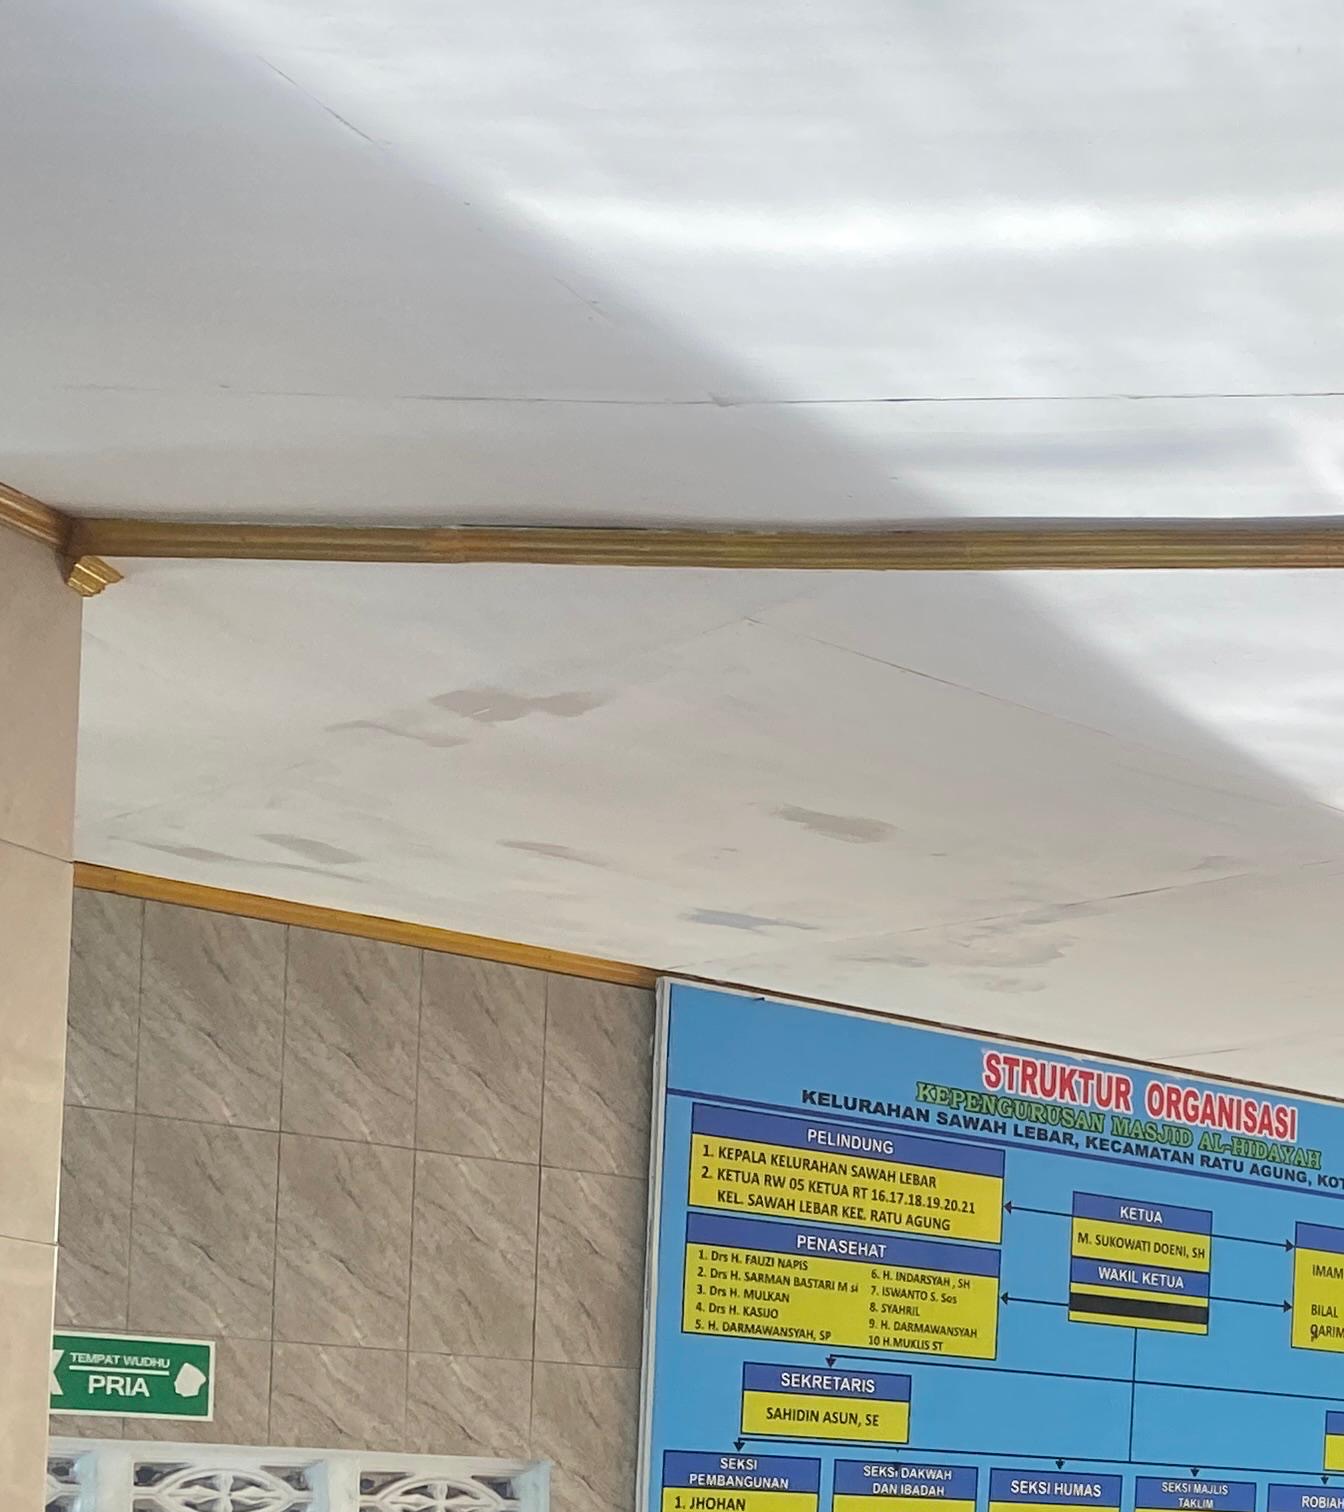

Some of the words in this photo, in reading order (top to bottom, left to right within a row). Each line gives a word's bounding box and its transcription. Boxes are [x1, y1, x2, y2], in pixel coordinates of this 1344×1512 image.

[983, 1050, 1132, 1113] STRUKTUR
[1146, 1081, 1297, 1141] ORGANISASI
[916, 1081, 1105, 1133] KEPENGURUSAN
[1112, 1116, 1193, 1147] MASJID
[1200, 1132, 1322, 1170] AL-HIDAYAH
[802, 1089, 930, 1122] KELURAHAN
[937, 1111, 1006, 1135] SAWAH
[1014, 1124, 1079, 1149] LEBAR,
[1086, 1132, 1194, 1166] KECAMATAN
[1200, 1156, 1244, 1173] RATU
[1250, 1163, 1312, 1186] AGUNG,
[807, 1128, 894, 1154] PELINDUNG
[702, 1144, 714, 1157] 1.
[718, 1146, 766, 1165] KEPALA
[770, 1153, 847, 1176] KELURAHAN
[851, 1165, 896, 1183] SAWAH
[899, 1172, 937, 1188] LEBAR
[701, 1166, 713, 1179] 2.
[717, 1168, 759, 1186] KETUA
[764, 1174, 785, 1189] RW
[789, 1178, 804, 1191] 05
[808, 1179, 850, 1196] KETUA
[852, 1187, 867, 1200] RT
[871, 1189, 975, 1214] 16.17.18.19.20.21
[717, 1190, 743, 1204] KEL.
[748, 1194, 796, 1212] SAWAH
[800, 1201, 838, 1217] LEBAR
[870, 1209, 902, 1224] RATU
[906, 1214, 951, 1231] AGUNG
[1120, 1206, 1163, 1223] KETUA
[797, 1234, 887, 1258] PENASEHAT
[1077, 1232, 1092, 1244] M.
[1095, 1234, 1151, 1253] SUKOWATI
[1153, 1242, 1189, 1258] DOENI,
[1192, 1247, 1205, 1259] SH
[698, 1250, 707, 1260] 1.
[711, 1251, 728, 1262] Drs
[731, 1253, 742, 1263] H.
[745, 1254, 774, 1267] FAUZI
[778, 1258, 808, 1271] NAPIS
[697, 1267, 706, 1277] 2.
[710, 1268, 727, 1279] Drs
[730, 1270, 741, 1280] H.
[744, 1272, 790, 1286] SARMAN
[794, 1276, 835, 1290] BASTARI
[838, 1282, 848, 1291] M
[871, 1269, 880, 1279] 6.
[883, 1270, 892, 1280] H.
[896, 1272, 950, 1286] INDARSYAH
[958, 1278, 970, 1289] SH
[1098, 1266, 1138, 1283] WAKIL
[1142, 1271, 1184, 1288] KETUA
[1312, 1264, 1344, 1279] IMAM
[696, 1286, 706, 1295] 3.
[710, 1286, 726, 1297] Drs
[730, 1288, 740, 1298] H.
[744, 1289, 790, 1303] MULKAN
[882, 1286, 927, 1300] ISWANTO
[696, 1302, 705, 1312] 4.
[709, 1303, 725, 1314] Drs
[729, 1305, 740, 1315] H.
[881, 1303, 920, 1316] SYAHRIL
[1311, 1304, 1338, 1318] BILAL
[708, 1320, 718, 1331] H.
[722, 1321, 816, 1341] DARMAWANSYAH,
[819, 1329, 831, 1340] SP
[881, 1320, 890, 1330] H.
[894, 1321, 977, 1338] DARMAWANSYAH
[933, 1341, 943, 1351] ST
[70, 1352, 120, 1365] TEMPAT
[124, 1355, 170, 1368] WUDHU
[88, 1375, 150, 1397] PRIA
[781, 1372, 875, 1393] SEKRETARIS
[766, 1407, 819, 1422] SAHIDIN
[823, 1412, 862, 1428] ASUN,
[865, 1414, 879, 1426] SE
[720, 1458, 757, 1470] SEKSI
[689, 1473, 789, 1489] PEMBANGUNAN
[901, 1467, 952, 1480] DAKWAH
[872, 1483, 897, 1495] DAN
[901, 1484, 945, 1496] IBADAH
[1010, 1480, 1051, 1495] SEKSI
[1055, 1482, 1101, 1497] HUMAS
[1162, 1482, 1191, 1493] SEKSI
[1193, 1483, 1228, 1495] MAJLIS
[674, 1496, 685, 1510] 1.
[689, 1497, 746, 1511] JHOHAN
[1178, 1498, 1213, 1509] TAKLIM
[1302, 1495, 1344, 1509] ROBIAH
